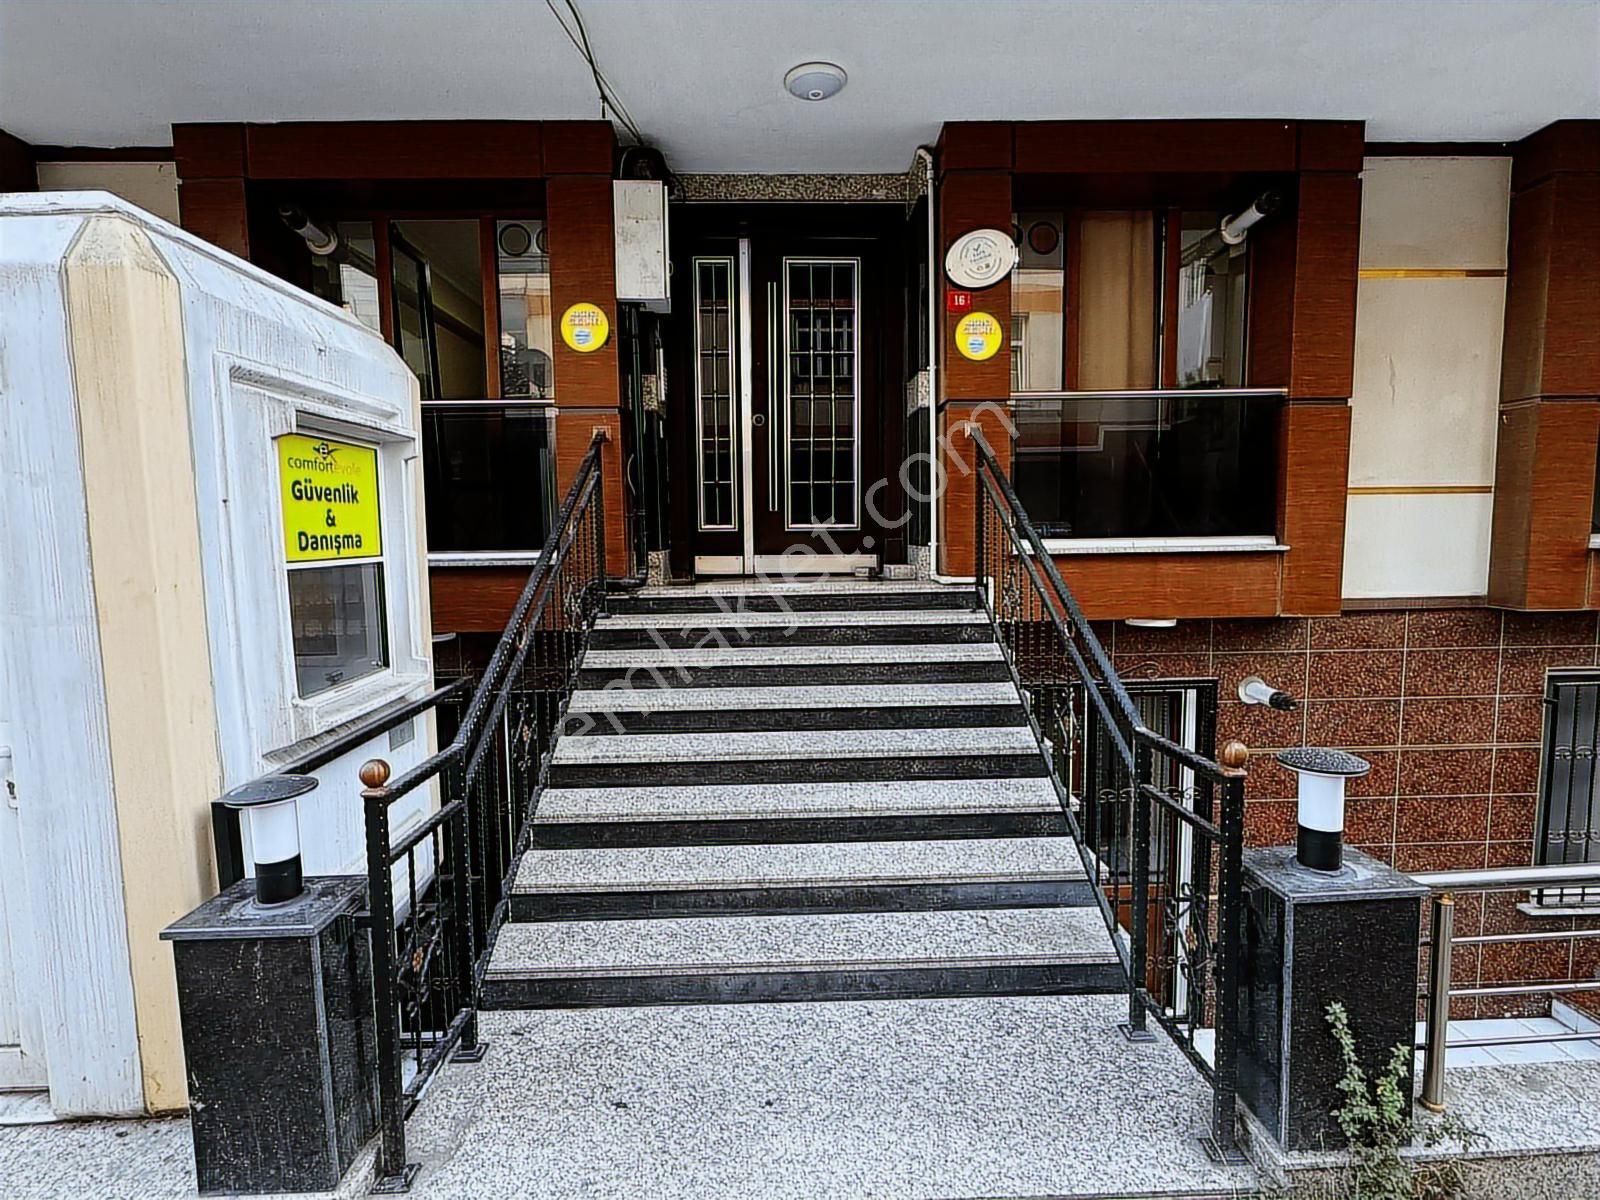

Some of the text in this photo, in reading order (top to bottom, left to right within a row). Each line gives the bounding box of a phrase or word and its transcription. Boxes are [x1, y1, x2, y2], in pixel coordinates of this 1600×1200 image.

[954, 295, 965, 305] 16
[291, 478, 359, 504] Güvenlik
[325, 508, 336, 527] &
[298, 531, 362, 555] Danışma
